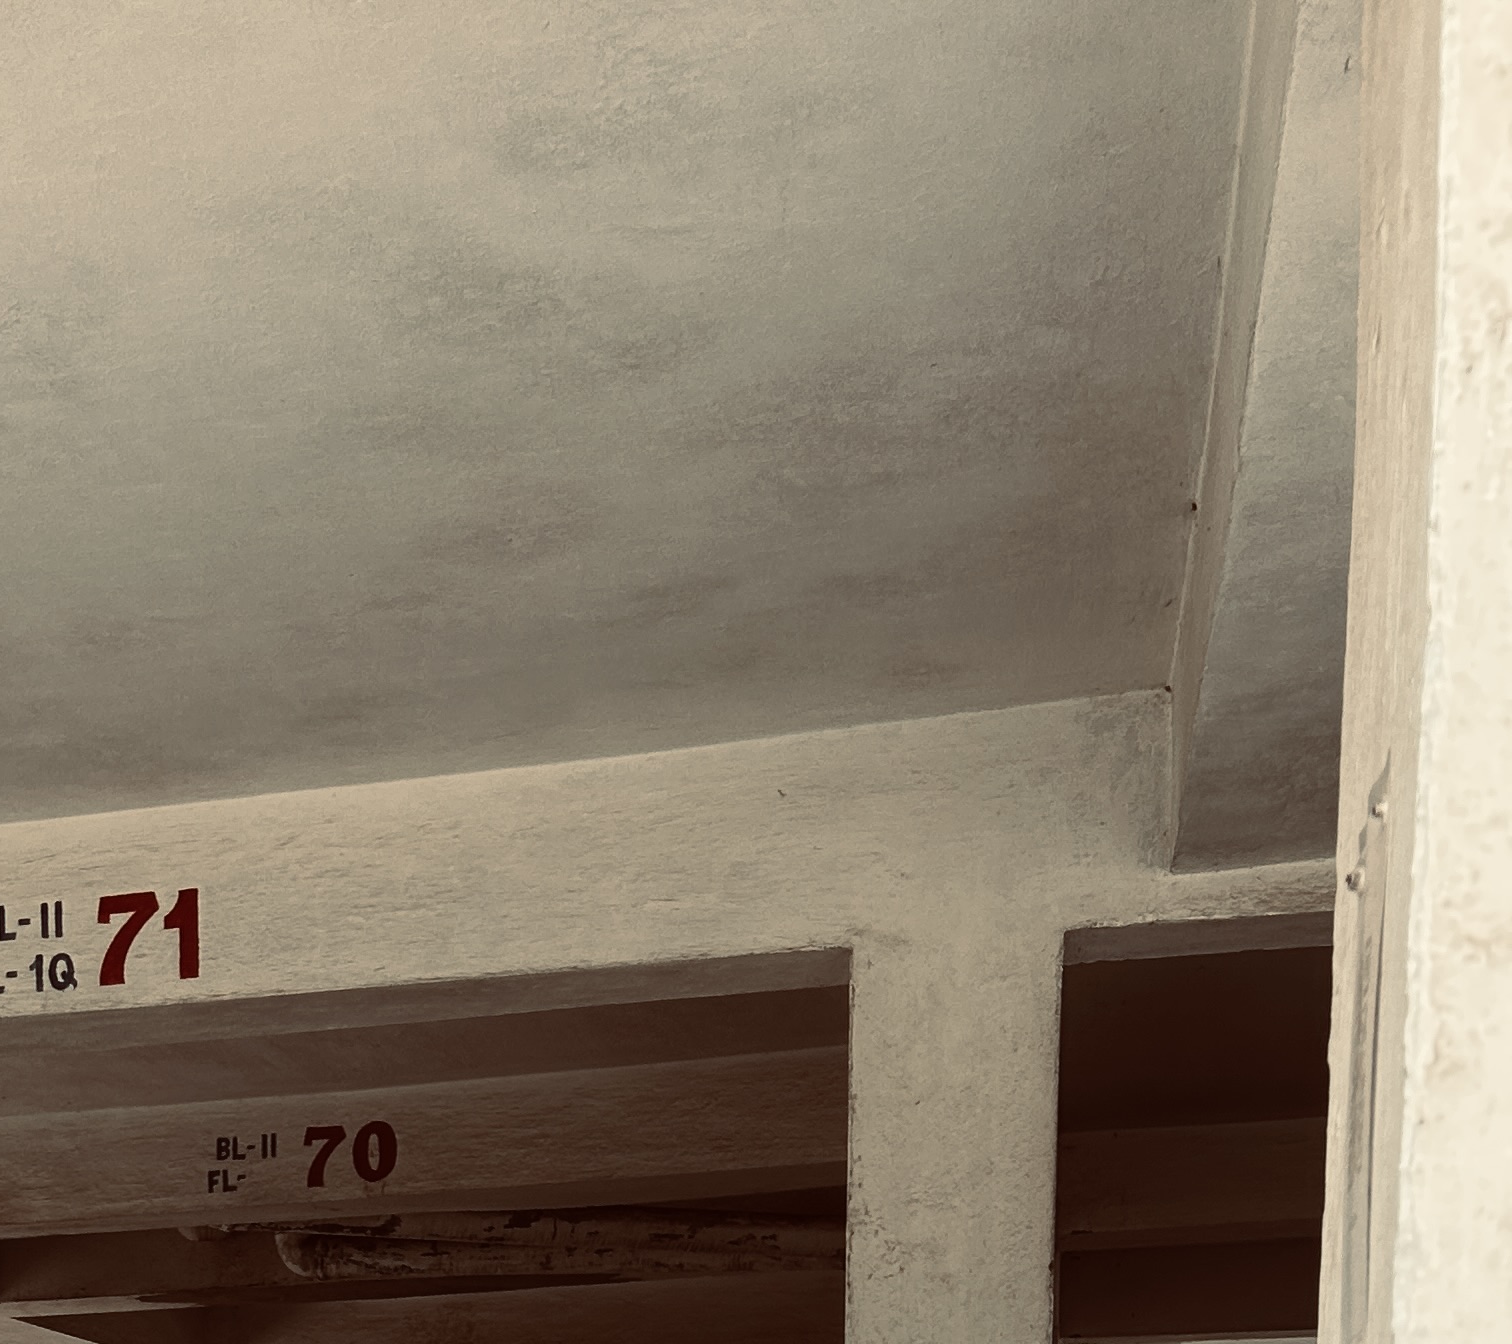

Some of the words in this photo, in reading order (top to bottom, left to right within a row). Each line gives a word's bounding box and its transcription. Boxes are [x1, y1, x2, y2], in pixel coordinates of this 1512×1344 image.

[96, 888, 201, 987] 71
[207, 1169, 247, 1194] FL-
[303, 1120, 399, 1189] 70
